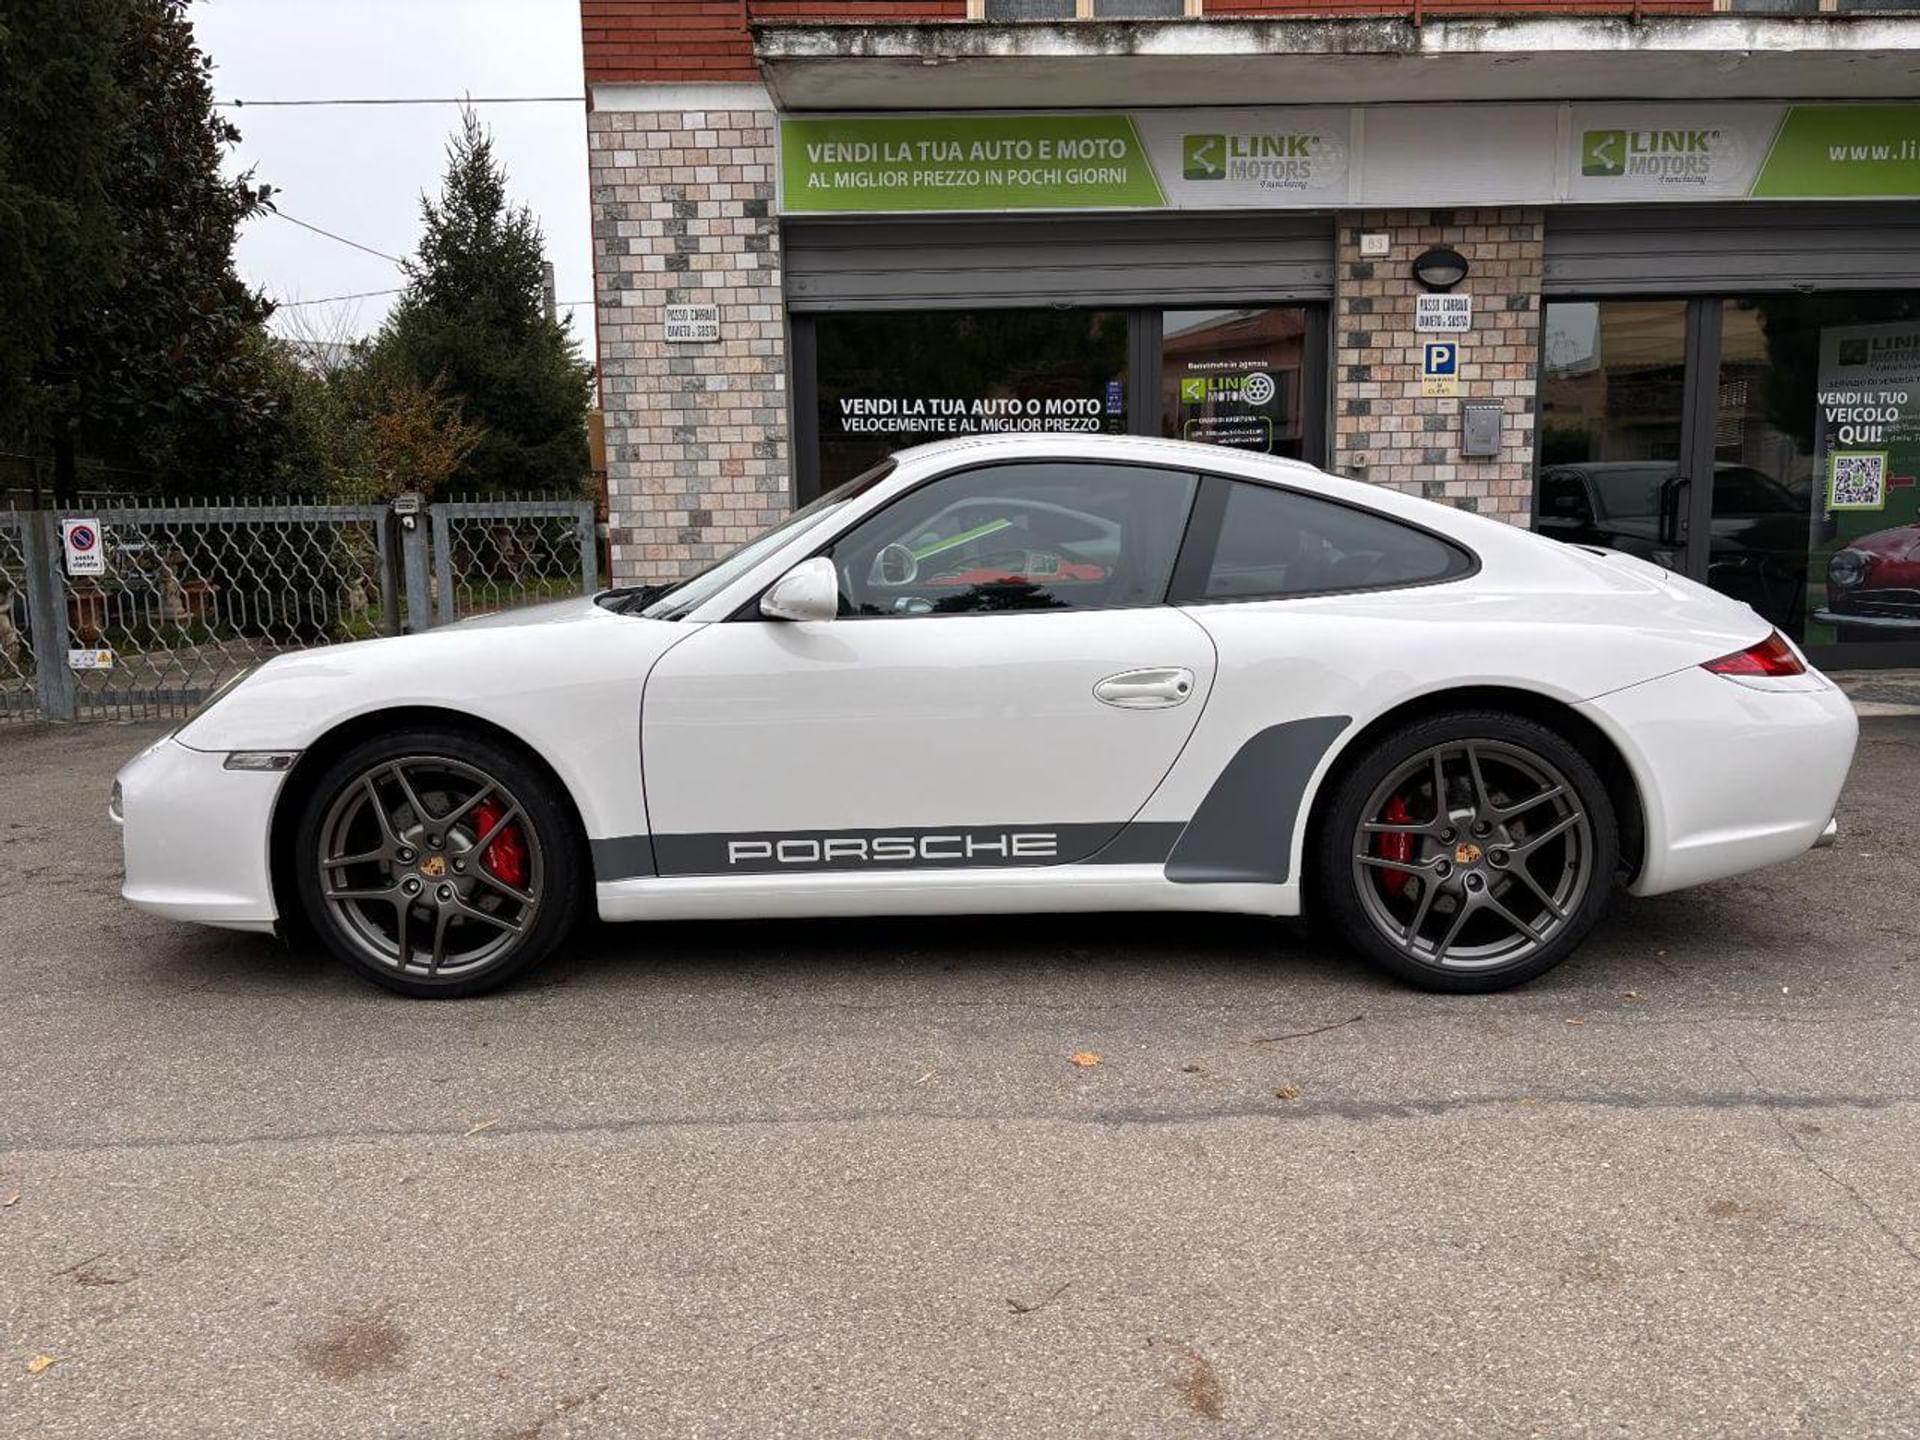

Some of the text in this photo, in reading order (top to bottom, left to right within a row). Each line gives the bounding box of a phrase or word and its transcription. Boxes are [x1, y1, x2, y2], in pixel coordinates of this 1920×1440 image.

[807, 139, 1126, 163] VENDI LA TUA AUTO E MOTO
[1828, 139, 1920, 161] www.li
[1230, 160, 1311, 181] MOTORS
[1629, 155, 1711, 176] MOTORS
[807, 167, 1127, 188] AL MIGLIOR PREZZO IN POCHI GIORNI
[1431, 346, 1450, 372] P
[840, 398, 1101, 415] VENDI LA TUA AUTO O MOTO
[1207, 391, 1249, 402] MOTOR
[1818, 391, 1908, 405] VENDI IL TUO
[841, 417, 1101, 432] VELOCEMENTE E AL MIGLIOR PREZZO
[1825, 407, 1899, 422] VEICOLO
[1839, 424, 1884, 445] QUI!
[727, 832, 1058, 865] PORSCHE
